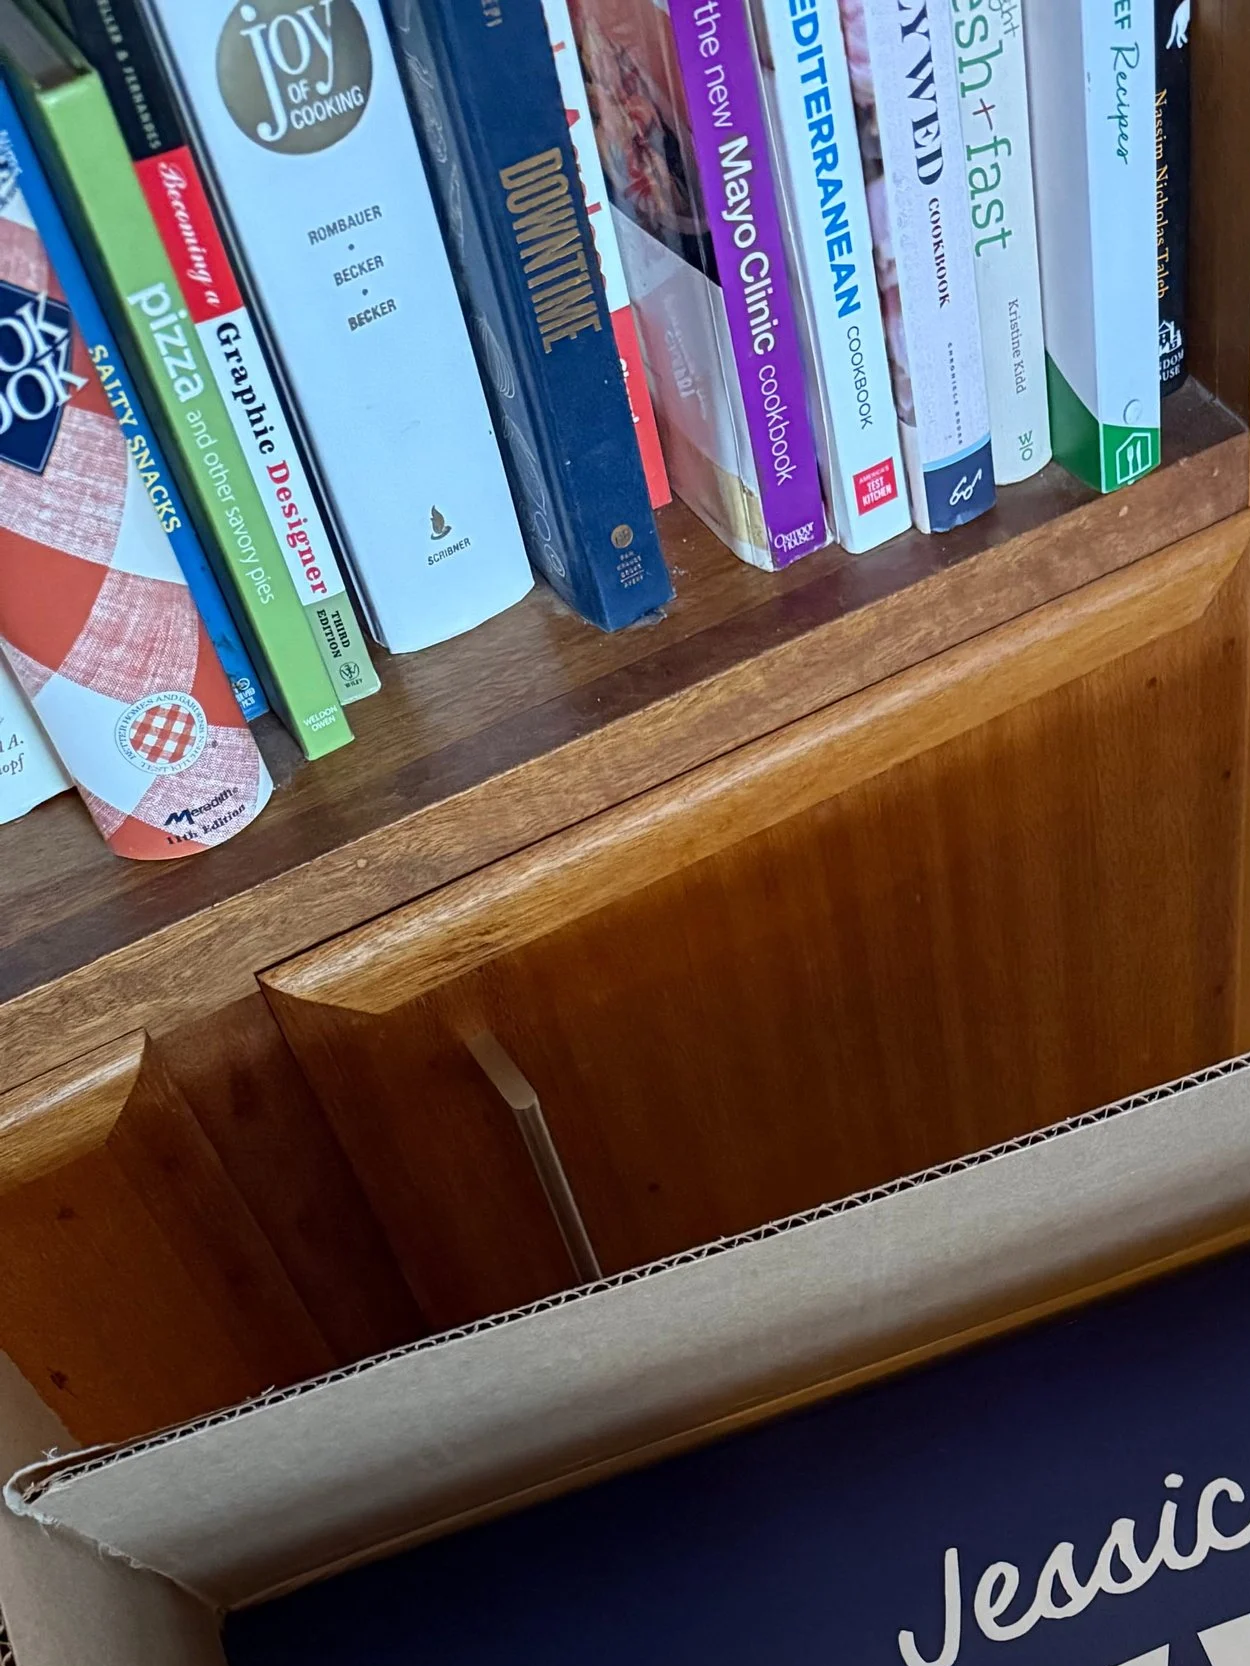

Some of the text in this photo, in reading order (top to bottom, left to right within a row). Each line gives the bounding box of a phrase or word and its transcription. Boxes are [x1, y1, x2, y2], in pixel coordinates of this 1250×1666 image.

[240, 0, 334, 142] joy
[287, 79, 311, 104] OF
[290, 85, 365, 129] COOKING
[1107, 41, 1140, 166] Recipes
[307, 205, 382, 245] ROMBAUER
[789, 0, 873, 430] EDITERRANEAN COOKBOOK
[966, 135, 1012, 257] fast
[1155, 88, 1170, 300] Nassim Nicholas Taleb
[333, 255, 384, 287] BECKER
[499, 147, 603, 354] DOWNTIME
[693, 0, 797, 487] the new Mayo Clinic cookbook
[928, 197, 950, 310] COOKBOOK
[0, 291, 69, 372] OK
[347, 299, 397, 331] BECKER
[1008, 299, 1027, 395] Kristine Kidd
[0, 337, 89, 435] OK
[158, 162, 328, 595] Becoming a Graphic Designer
[88, 344, 182, 534] SALTY SNACKS
[128, 281, 275, 605] pizza and other savory pies
[862, 483, 892, 506] KITCHEN
[866, 476, 884, 493] TEST
[427, 537, 471, 566] SCRIBNER
[316, 608, 342, 658] EDITION
[331, 610, 350, 648] THIRD
[303, 705, 338, 726] WELDON
[311, 716, 336, 732] OWEN
[201, 804, 246, 835] Edition
